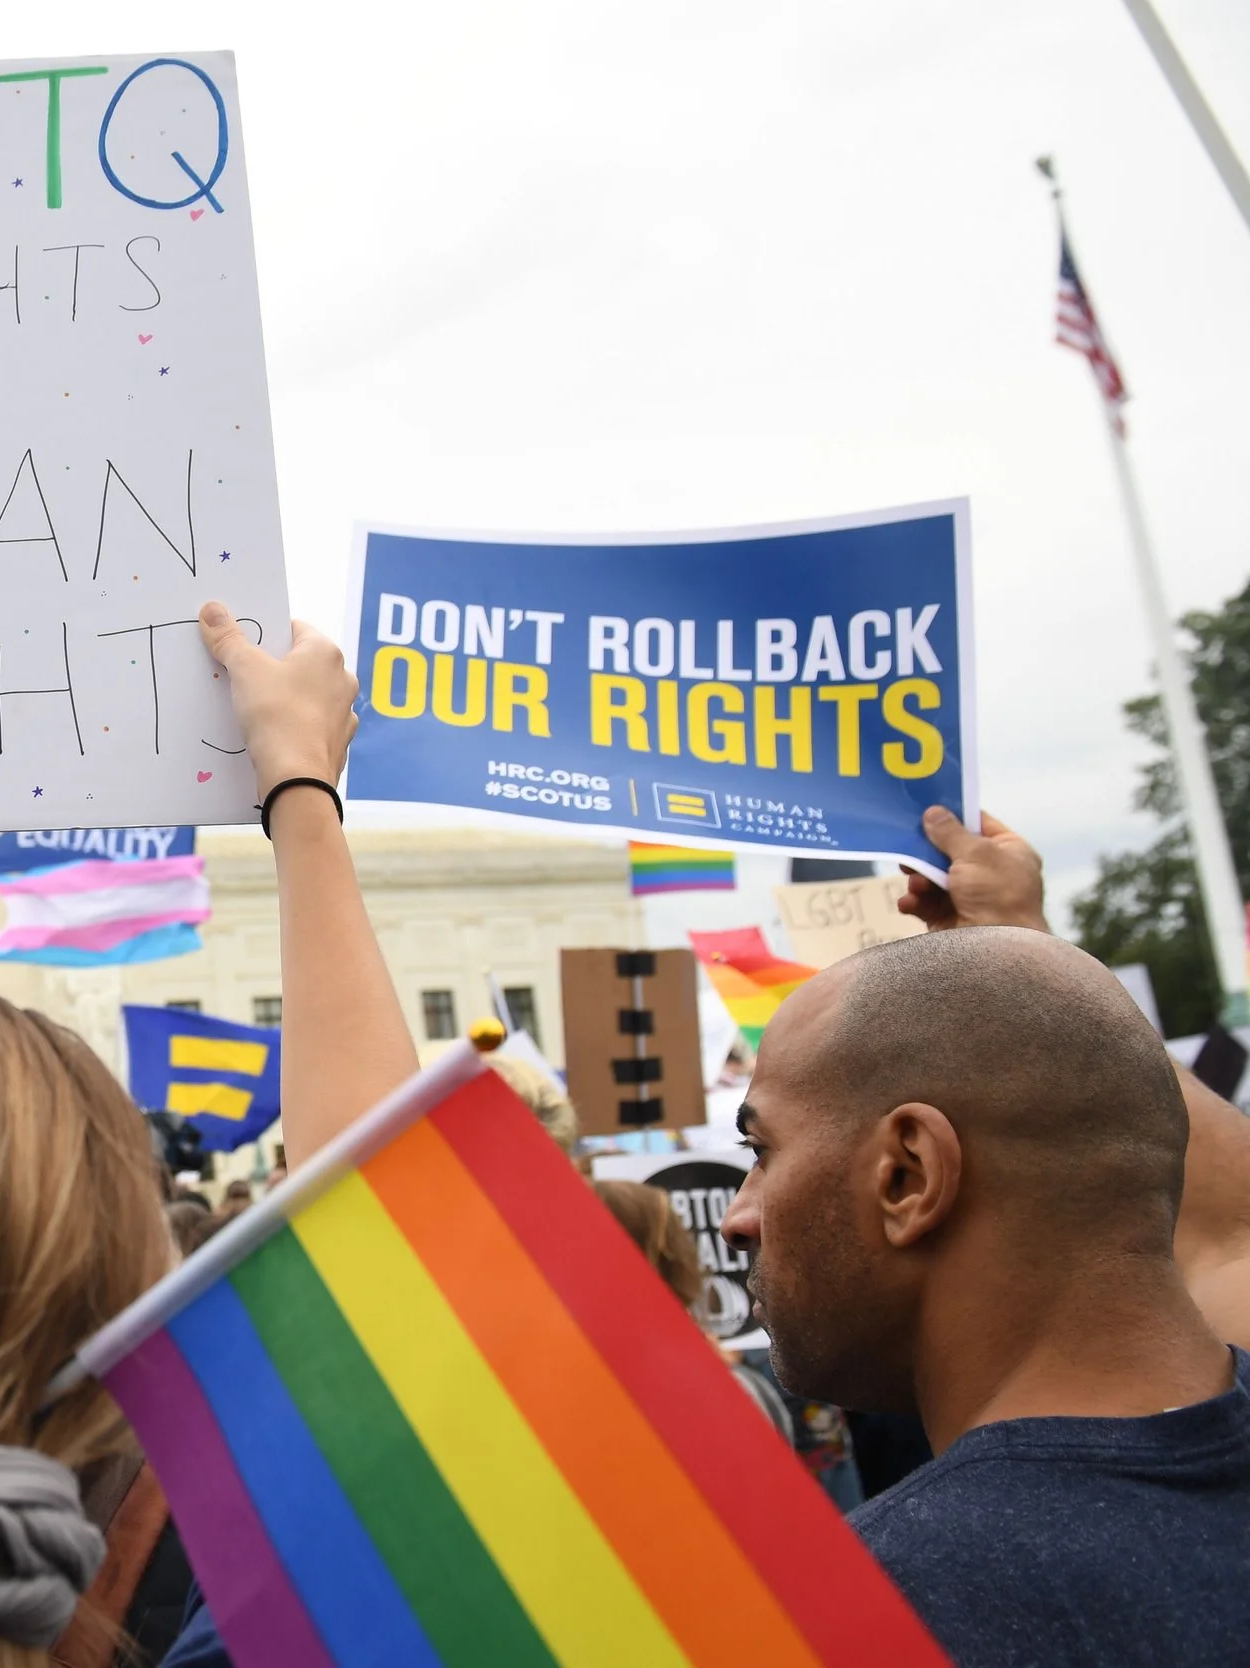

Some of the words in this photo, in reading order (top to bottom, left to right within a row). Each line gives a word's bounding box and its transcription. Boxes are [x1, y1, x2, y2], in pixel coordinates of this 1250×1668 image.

[377, 592, 564, 664] DON'T
[589, 603, 942, 683] ROLLBACK
[370, 646, 552, 738] OUR
[590, 677, 944, 780] RIGHTS
[487, 760, 610, 792] HRC.ORG
[485, 781, 612, 811] #SCOTUS
[725, 794, 823, 820] HUMAN
[728, 809, 828, 834] RIGHTS
